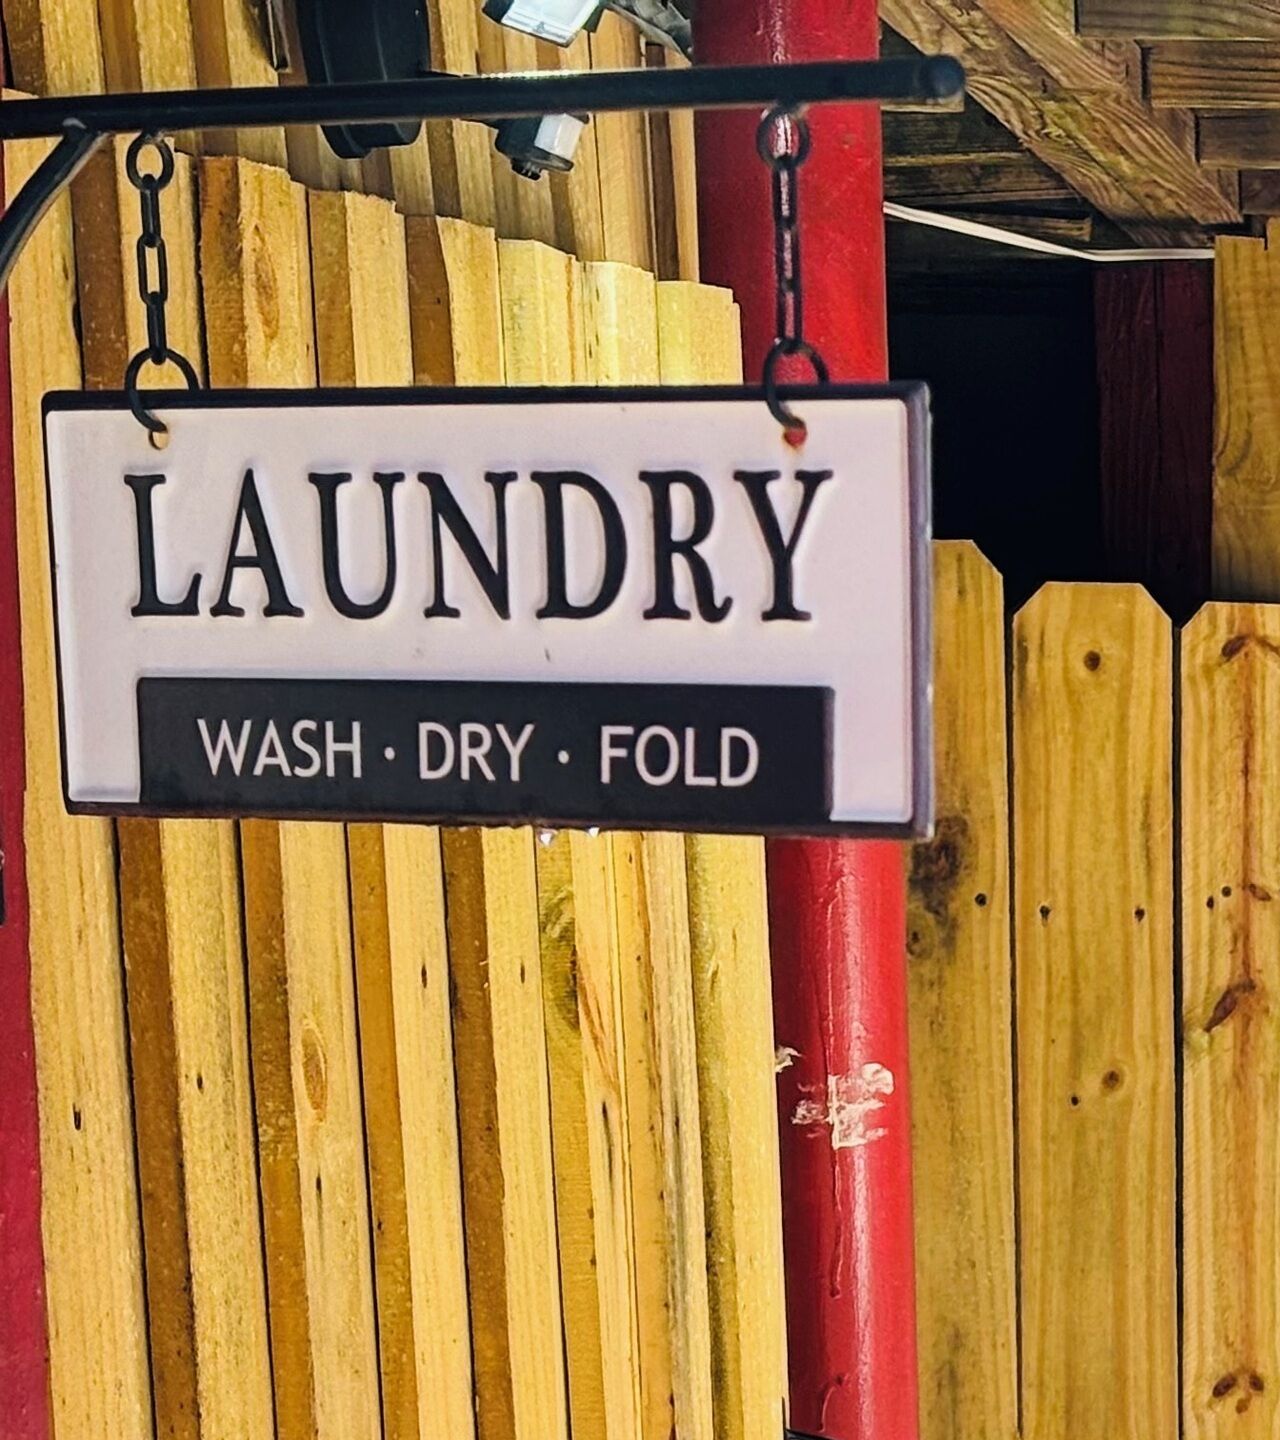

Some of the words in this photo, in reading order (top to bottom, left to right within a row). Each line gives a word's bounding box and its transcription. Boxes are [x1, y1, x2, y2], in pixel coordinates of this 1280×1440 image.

[123, 468, 833, 623] LAUNDRY
[196, 718, 363, 779] WASH
[417, 722, 535, 784] DRY
[600, 725, 761, 788] FOLD
